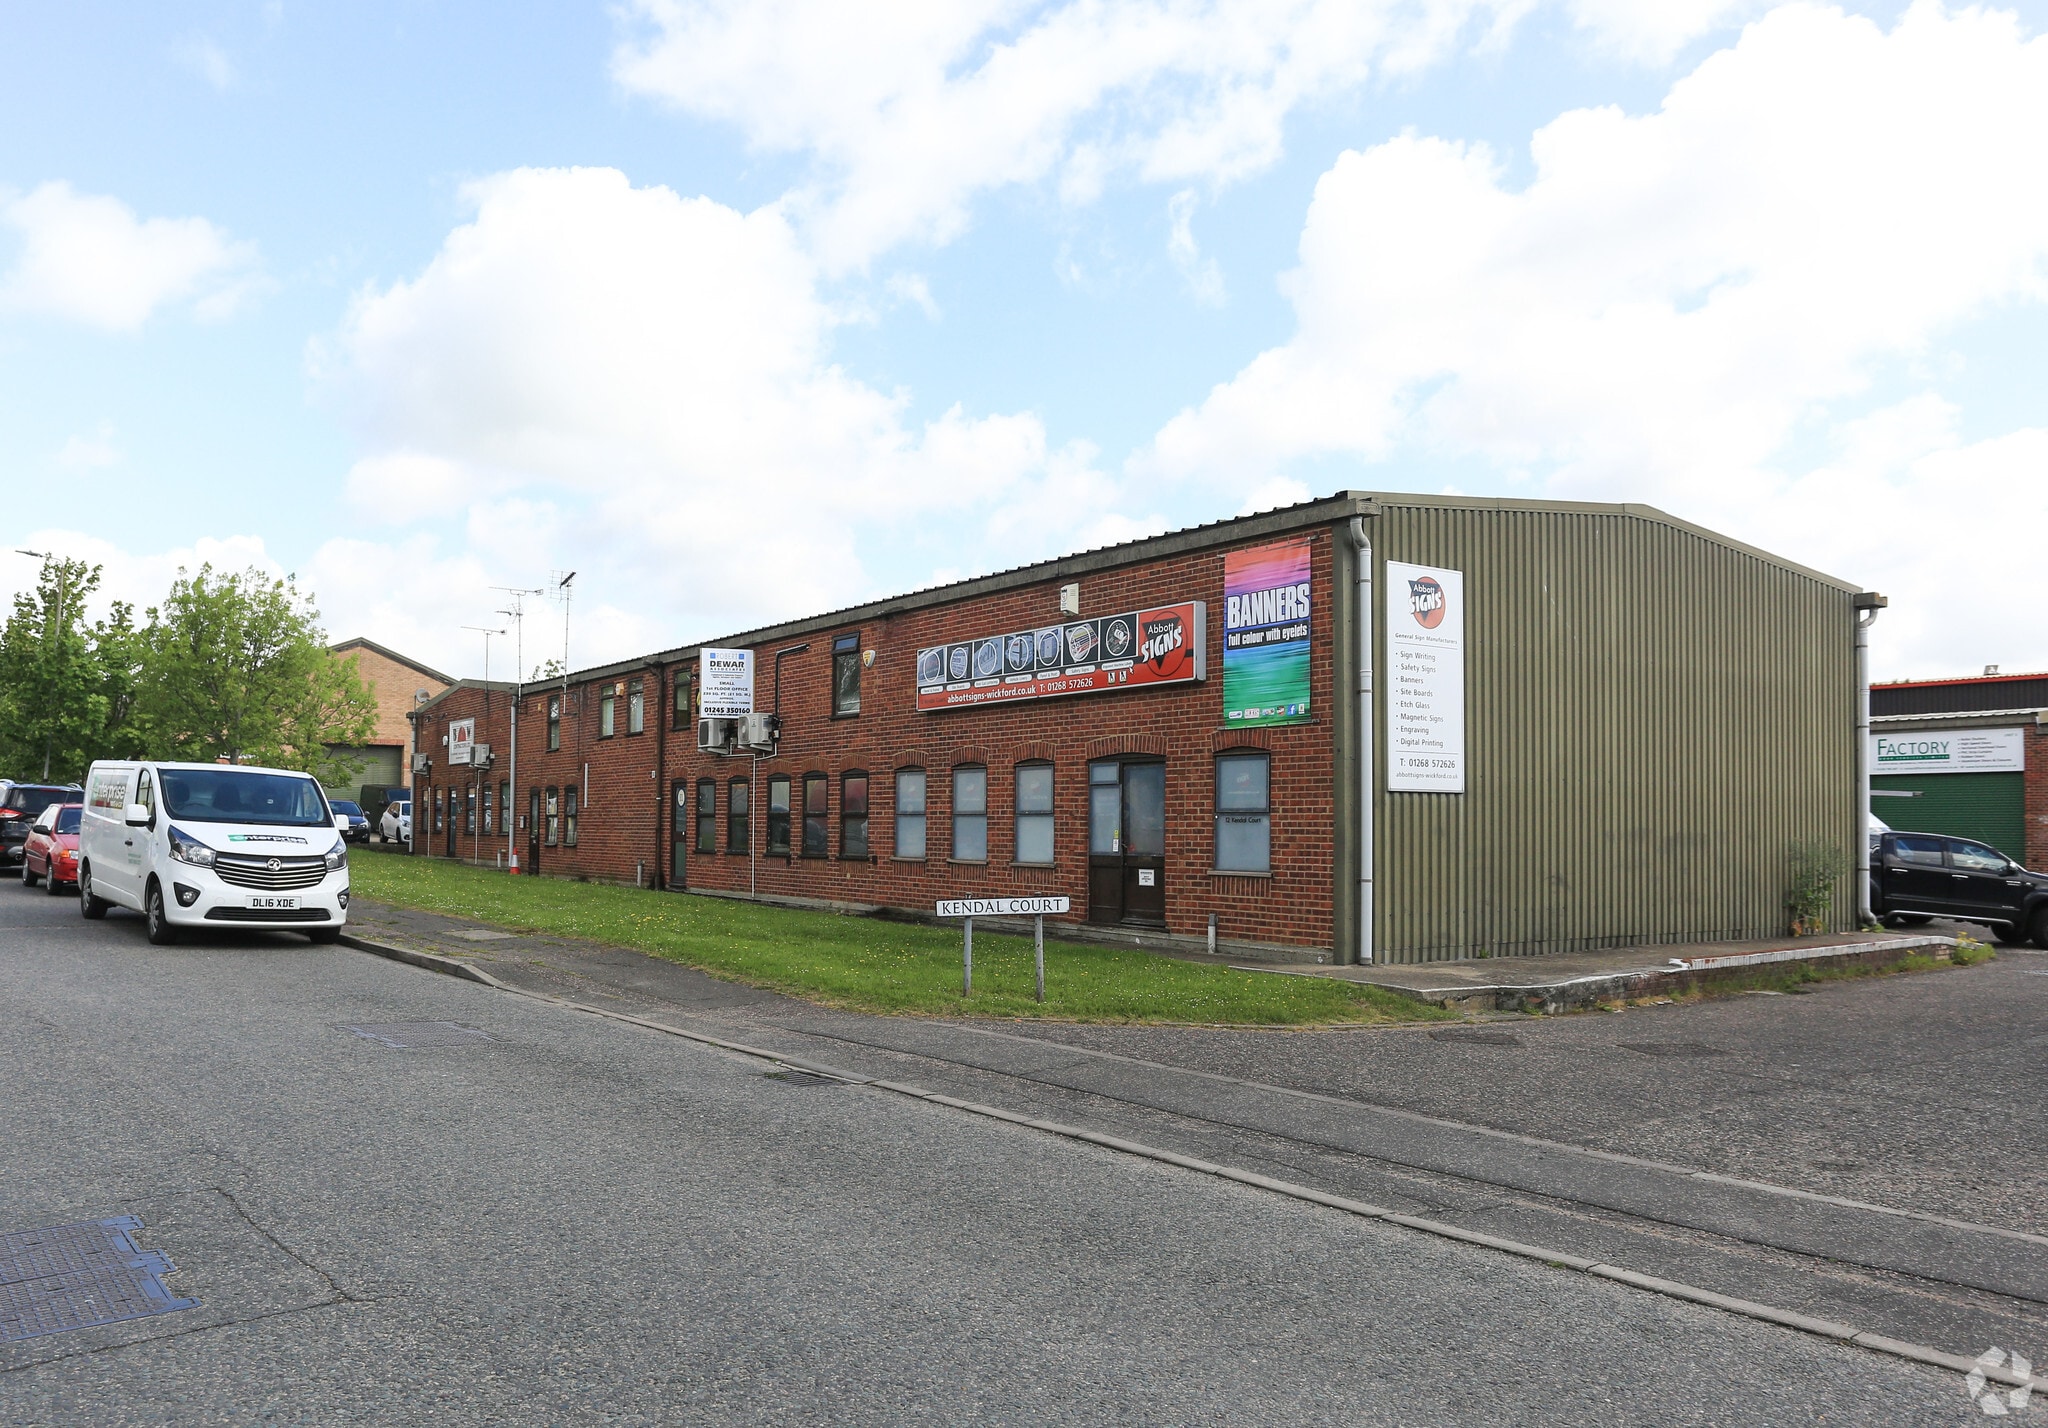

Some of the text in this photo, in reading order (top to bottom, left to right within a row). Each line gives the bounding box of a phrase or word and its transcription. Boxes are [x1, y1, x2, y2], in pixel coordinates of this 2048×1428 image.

[1414, 584, 1434, 594] Abbott
[1228, 583, 1310, 629] BANNERS
[1409, 592, 1442, 614] SIGNS
[1148, 622, 1174, 634] Abbott
[1228, 624, 1307, 646] full colour with eyelets
[1426, 636, 1458, 644] Manufacturers
[1141, 625, 1182, 663] SIGNS
[1400, 650, 1436, 662] Sign Writing
[1401, 663, 1436, 673] Safety Signs
[1400, 676, 1424, 684] Banners
[947, 684, 1036, 704] abbottsigns-wickford.co.uk
[1040, 684, 1046, 692] T:
[1047, 680, 1066, 692] 01268
[1069, 677, 1093, 689] 572626
[1414, 689, 1433, 697] Boards
[1400, 713, 1444, 723] Magnetic Signs
[1401, 726, 1429, 735] Engraving
[1400, 738, 1444, 748] Digital Printing
[1878, 738, 1949, 755] FACTORY
[1400, 758, 1456, 768] T: 01268 572626
[253, 899, 295, 908] DL16 XDE
[942, 899, 1062, 914] KENDAL COURT
